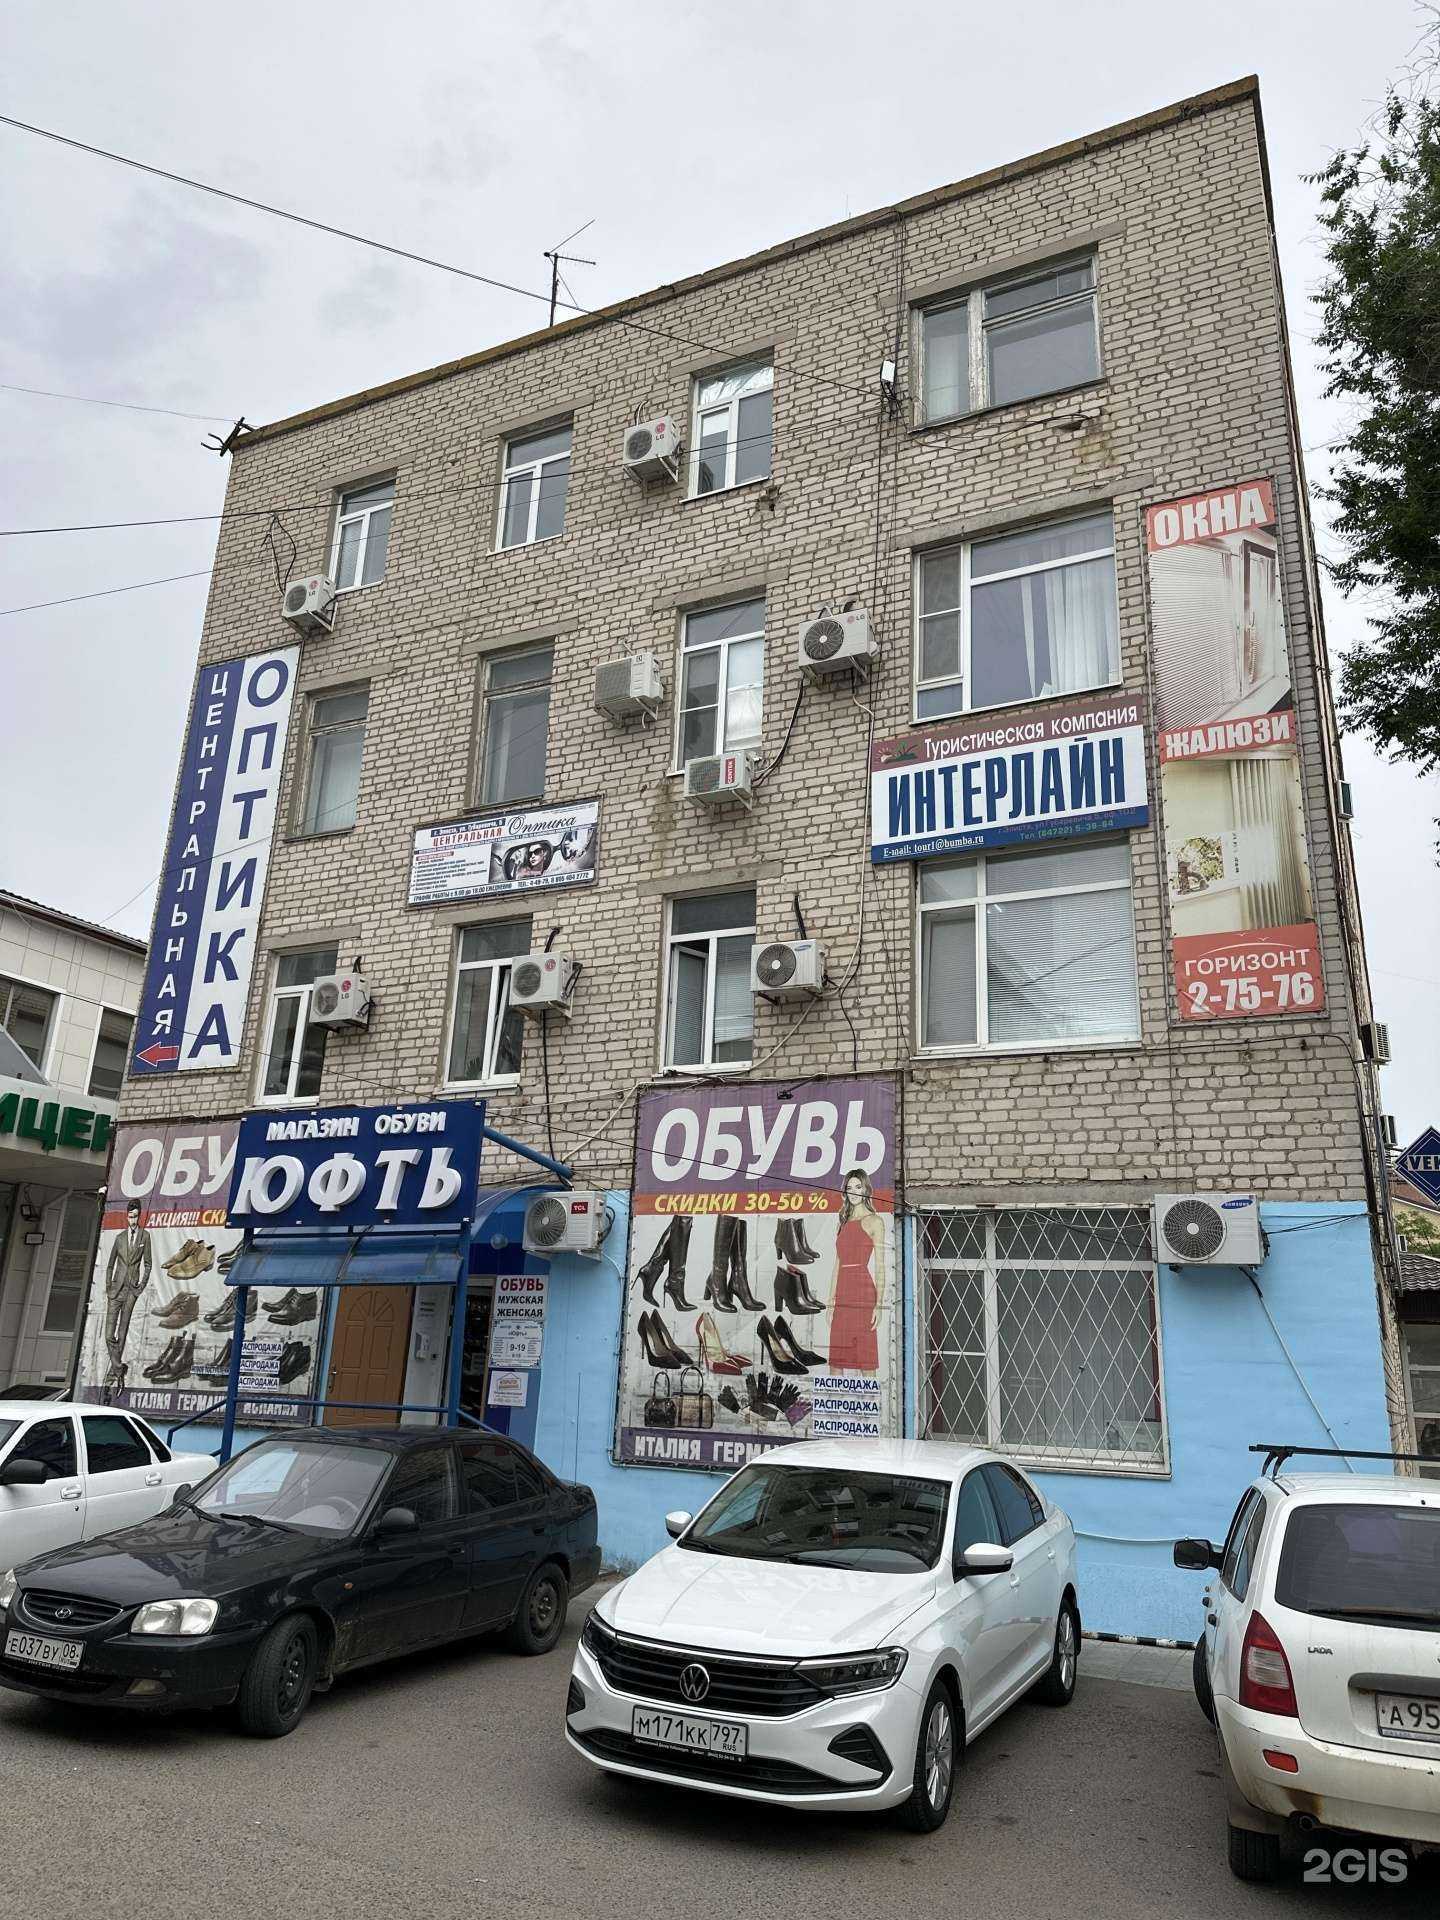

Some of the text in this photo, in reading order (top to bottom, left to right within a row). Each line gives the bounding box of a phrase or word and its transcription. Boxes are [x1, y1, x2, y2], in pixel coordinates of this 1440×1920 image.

[1153, 486, 1268, 547] ОКНА
[924, 704, 1138, 761] Туристическая компания
[1165, 713, 1291, 759] ЖАЛЮЗИ
[887, 735, 1126, 838] ИНТЕРЛАЙН
[433, 828, 502, 847] ЦЕНТРАЛЬНАЯ
[508, 815, 577, 836] Оптика
[151, 671, 229, 1036] ЦЕНТРАЛЬНАЯ
[187, 658, 289, 1059] ОПТИКА
[883, 844, 912, 858] E-mail:
[1184, 948, 1310, 977] ГОРИЗОНТ
[1188, 971, 1315, 1014] 2-75-76
[266, 1111, 447, 1142] МАГАЗИН ОБУВИ
[651, 1100, 886, 1182] ОБУВЬ
[120, 1135, 239, 1198] ОБУ
[230, 1147, 462, 1215] ЮФТЬ
[573, 1204, 587, 1212] TCL
[654, 1191, 829, 1215] СКИДКИ 30-50 %
[147, 1210, 200, 1228] АКЦИЯ!!!
[500, 1277, 544, 1292] ОБУВЬ
[497, 1295, 544, 1305] МУЖСКАЯ
[496, 1308, 543, 1318] ЖЕНСКАЯ
[242, 1342, 282, 1353] АСПРОДАЖА
[240, 1360, 279, 1370] АСПРОДАЖА
[239, 1376, 278, 1387] АСПРОДАЖА
[814, 1377, 879, 1391] РАСПРОДАЖА
[129, 1391, 170, 1411] ИТАЛИЯ
[813, 1398, 879, 1412] РАСПРОДАЖА
[813, 1420, 879, 1434] РАСПРОДАЖА
[634, 1435, 701, 1461] ИТАЛИЯ
[10, 1636, 77, 1661] Е037ВУ 08
[1307, 1646, 1334, 1656] LADA
[637, 1715, 741, 1747] М171КК 797
[722, 1742, 737, 1752] RUS
